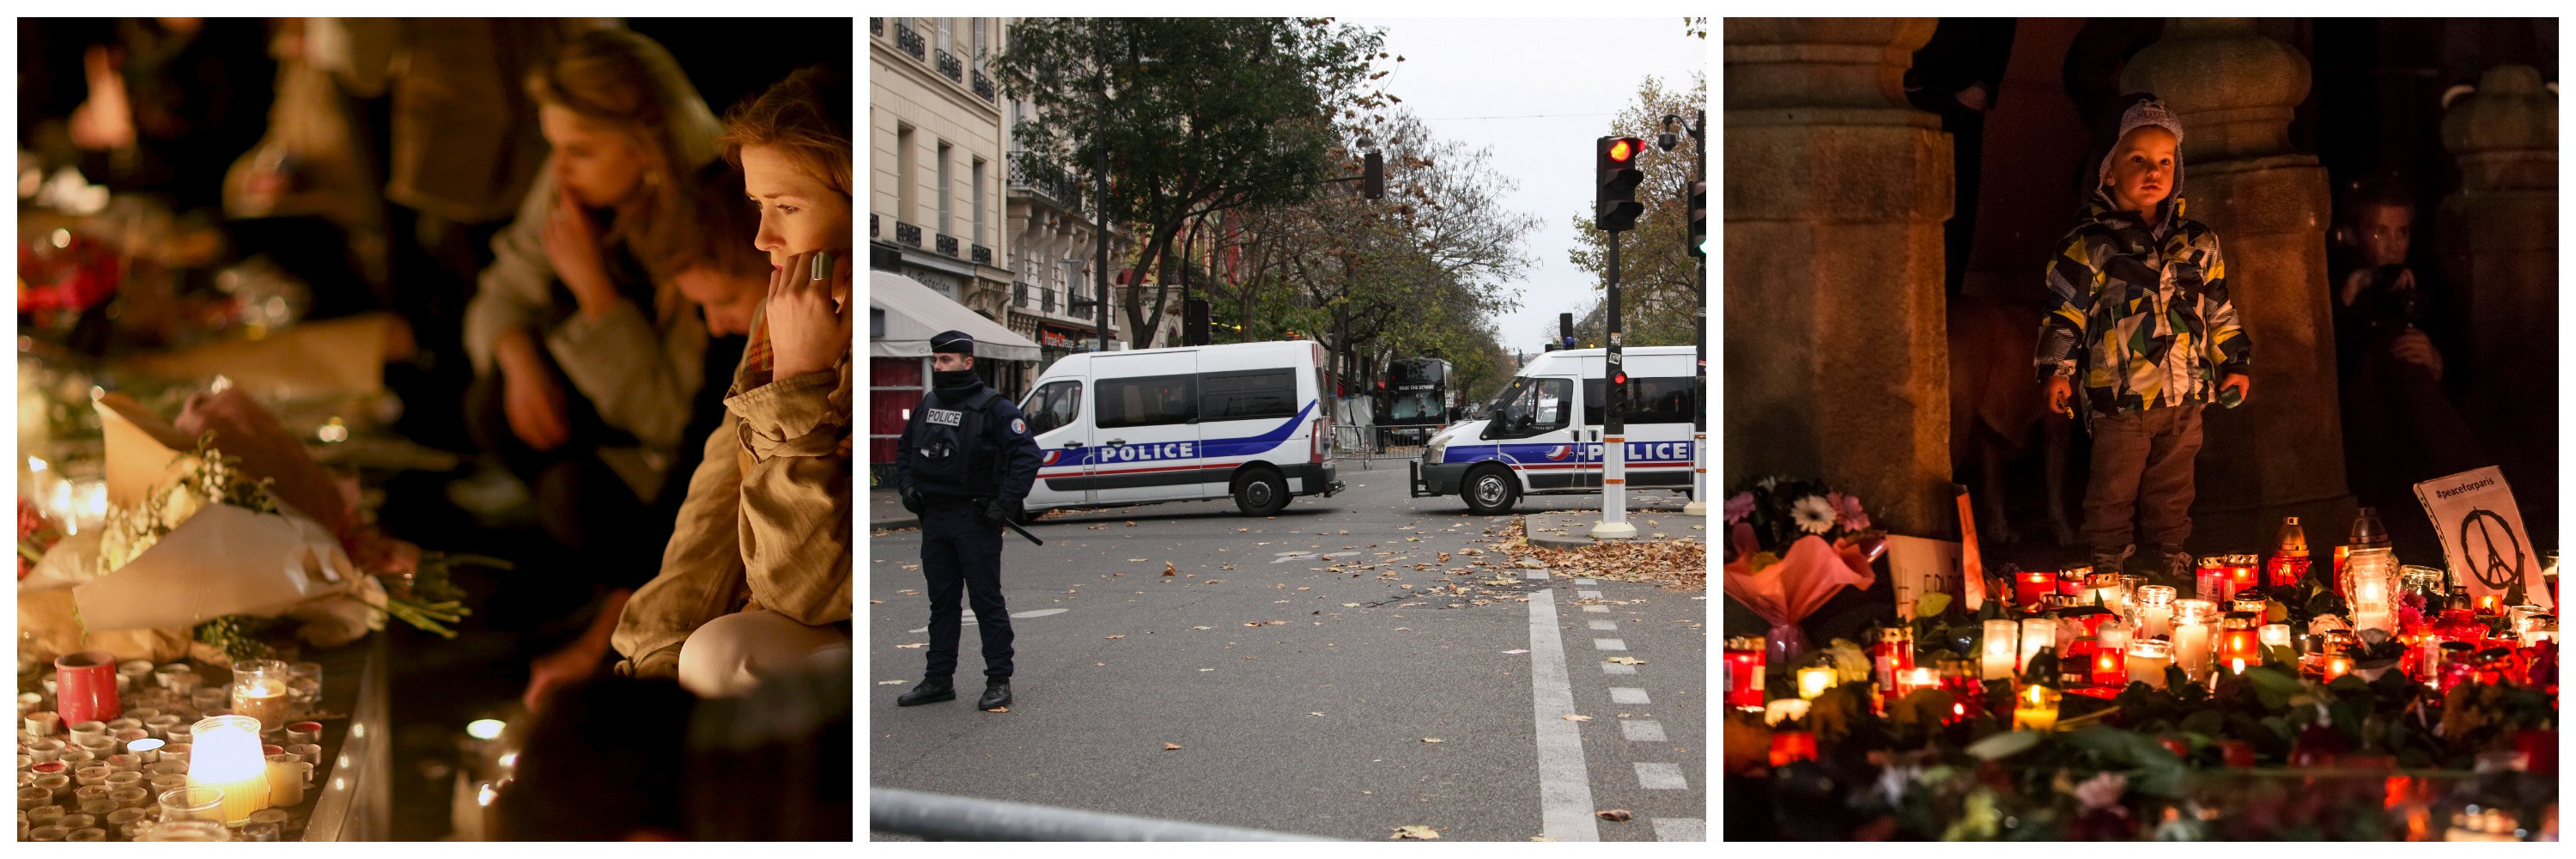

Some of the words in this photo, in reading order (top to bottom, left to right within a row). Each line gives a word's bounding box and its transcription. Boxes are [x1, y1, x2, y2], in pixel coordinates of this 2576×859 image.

[928, 411, 960, 424] POLICE
[1101, 442, 1194, 462] POLICE
[1589, 442, 1688, 460] PLICE
[2436, 477, 2494, 500] #peaceforparis
